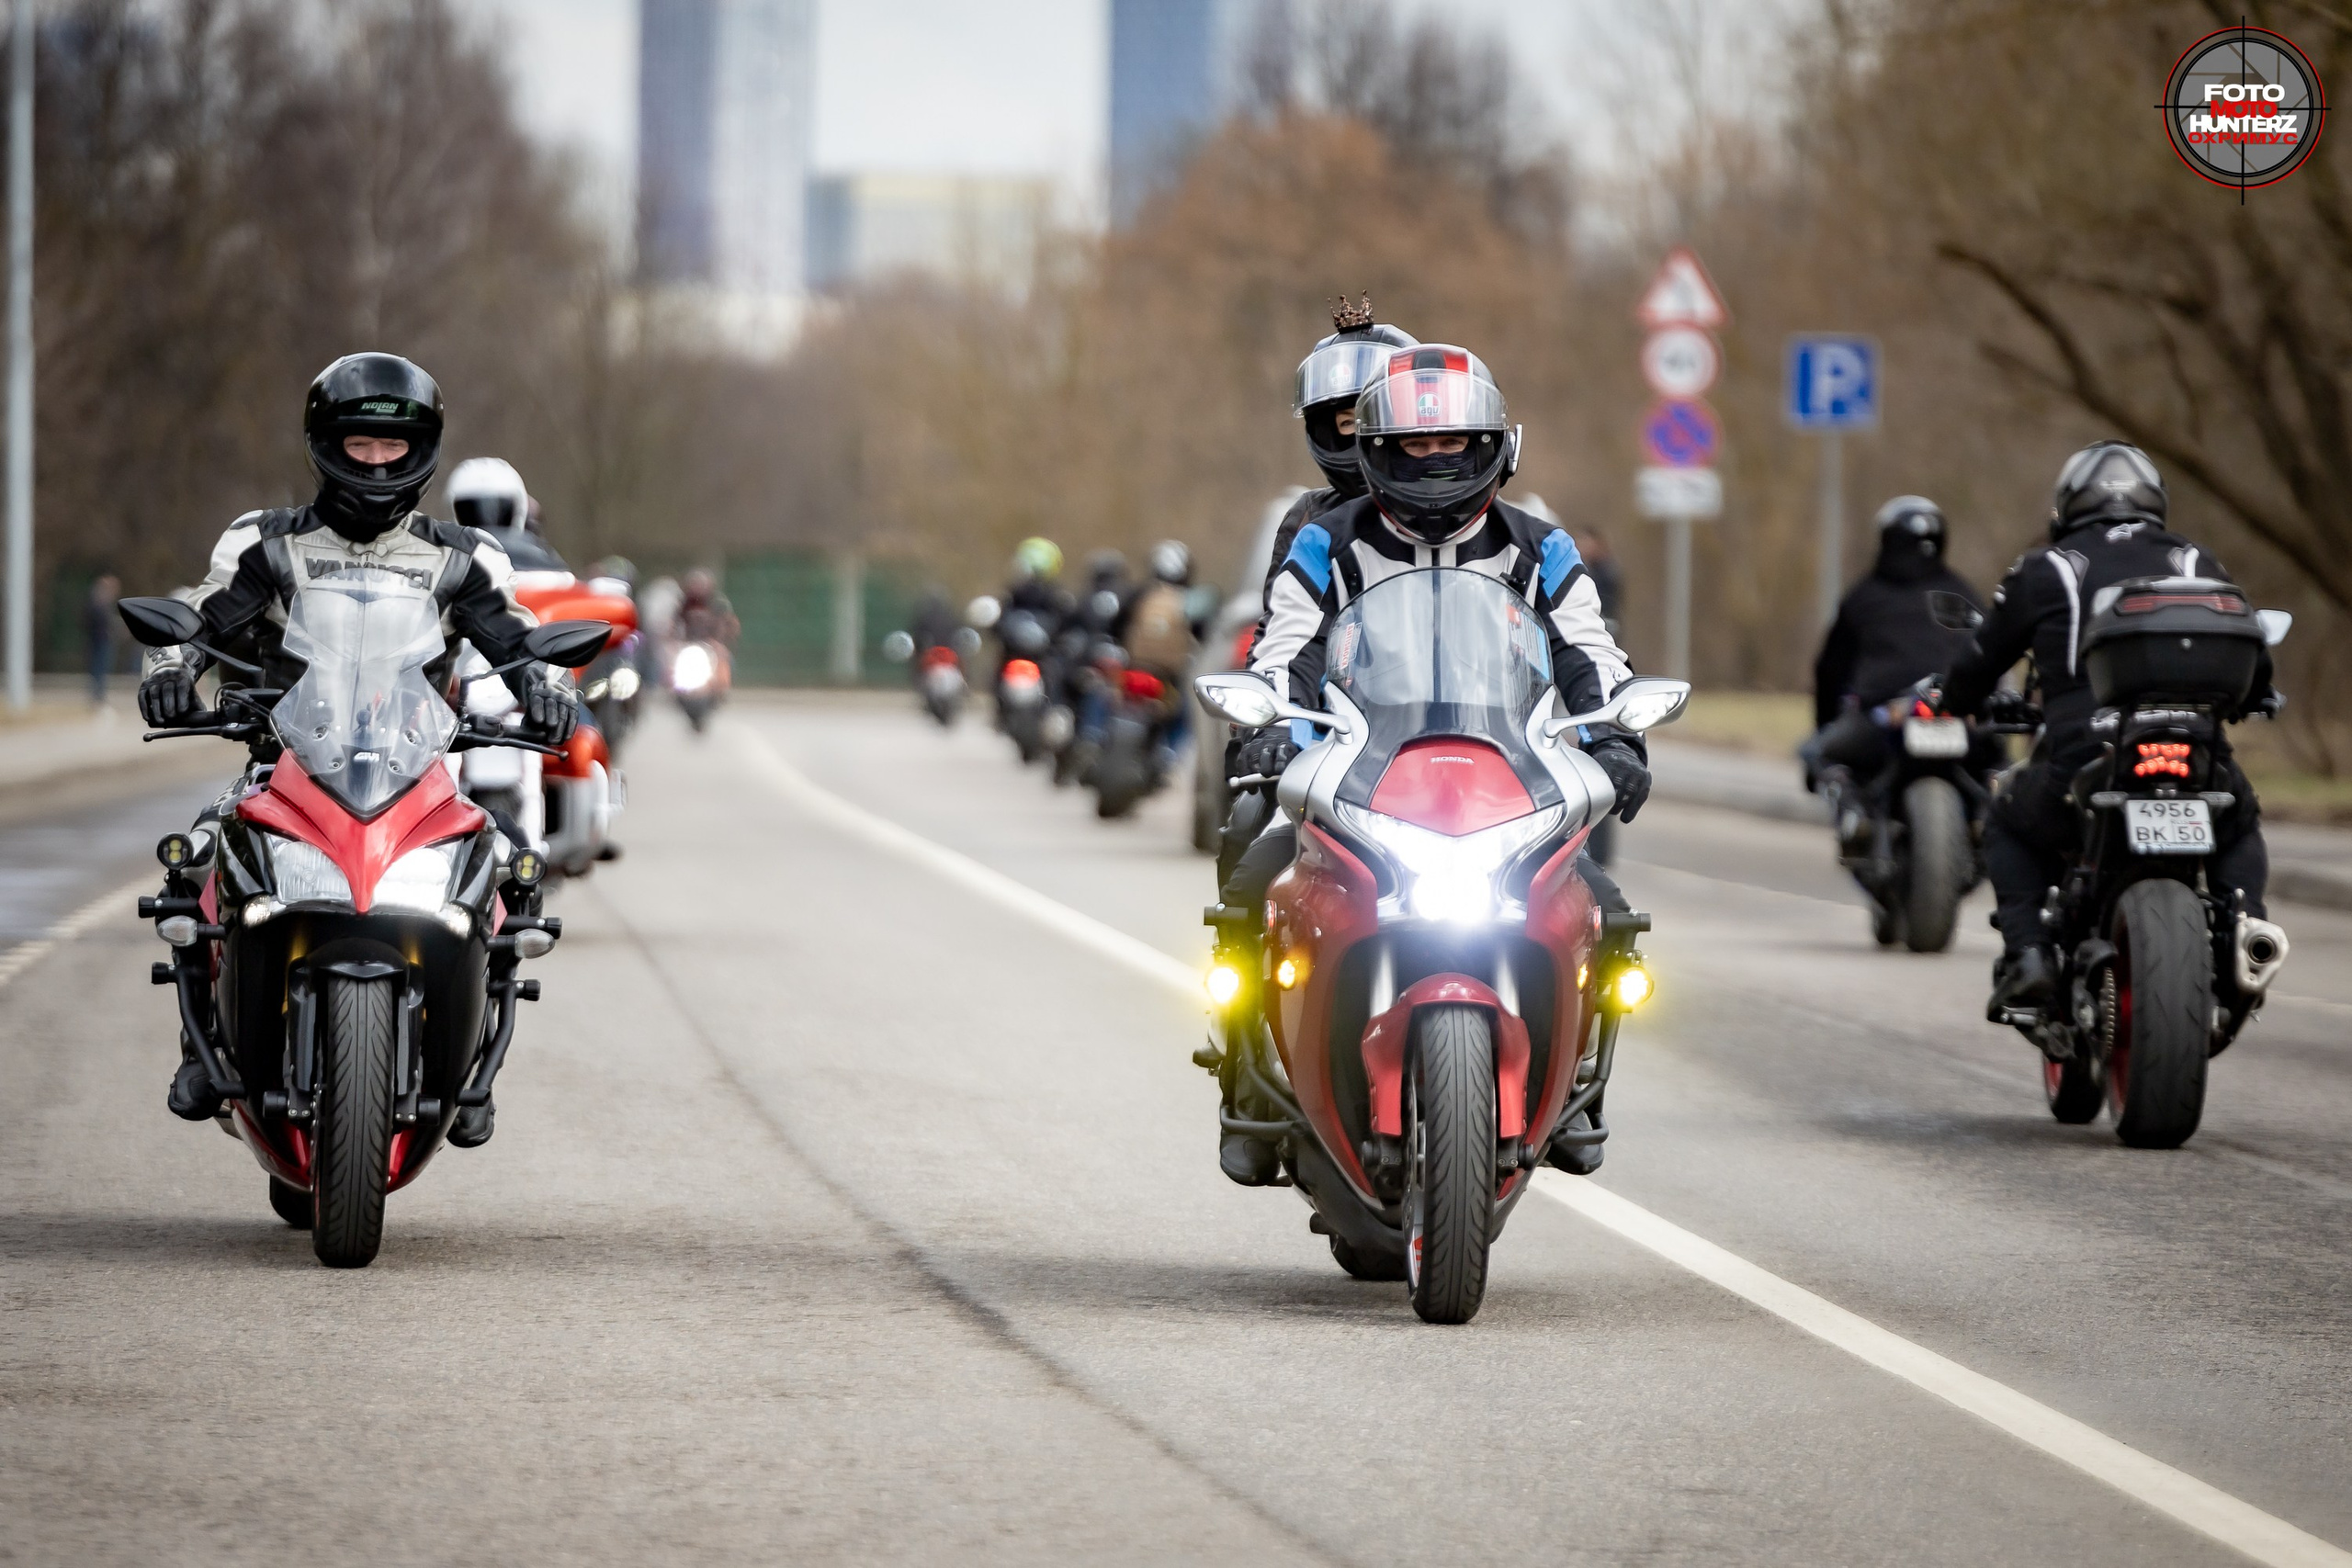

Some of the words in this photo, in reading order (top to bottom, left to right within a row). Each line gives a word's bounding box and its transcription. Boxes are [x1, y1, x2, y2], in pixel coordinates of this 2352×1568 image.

[1812, 343, 1865, 413] P
[361, 402, 399, 413] NOLAN
[1420, 406, 1439, 418] agv
[1430, 756, 1475, 764] HONDA
[2138, 803, 2196, 818] 4956
[2178, 827, 2205, 841] 50
